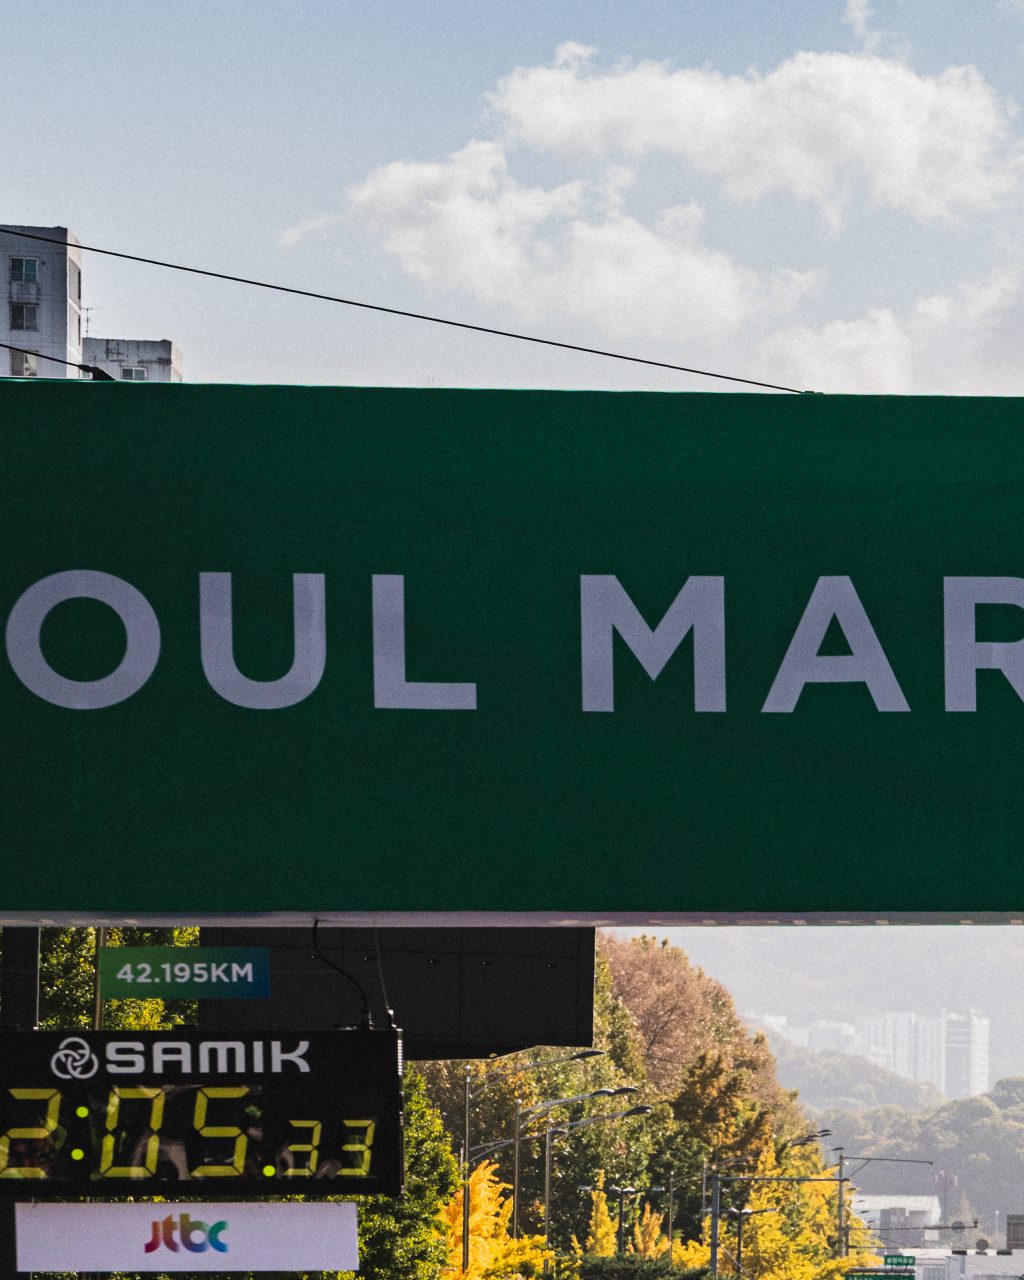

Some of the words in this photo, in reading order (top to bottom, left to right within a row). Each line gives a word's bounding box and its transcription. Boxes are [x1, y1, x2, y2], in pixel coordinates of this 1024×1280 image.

[6, 570, 477, 710] OUL
[117, 963, 253, 983] 42.195KM
[106, 1040, 310, 1074] SAMIK
[144, 1213, 229, 1254] jtbc
